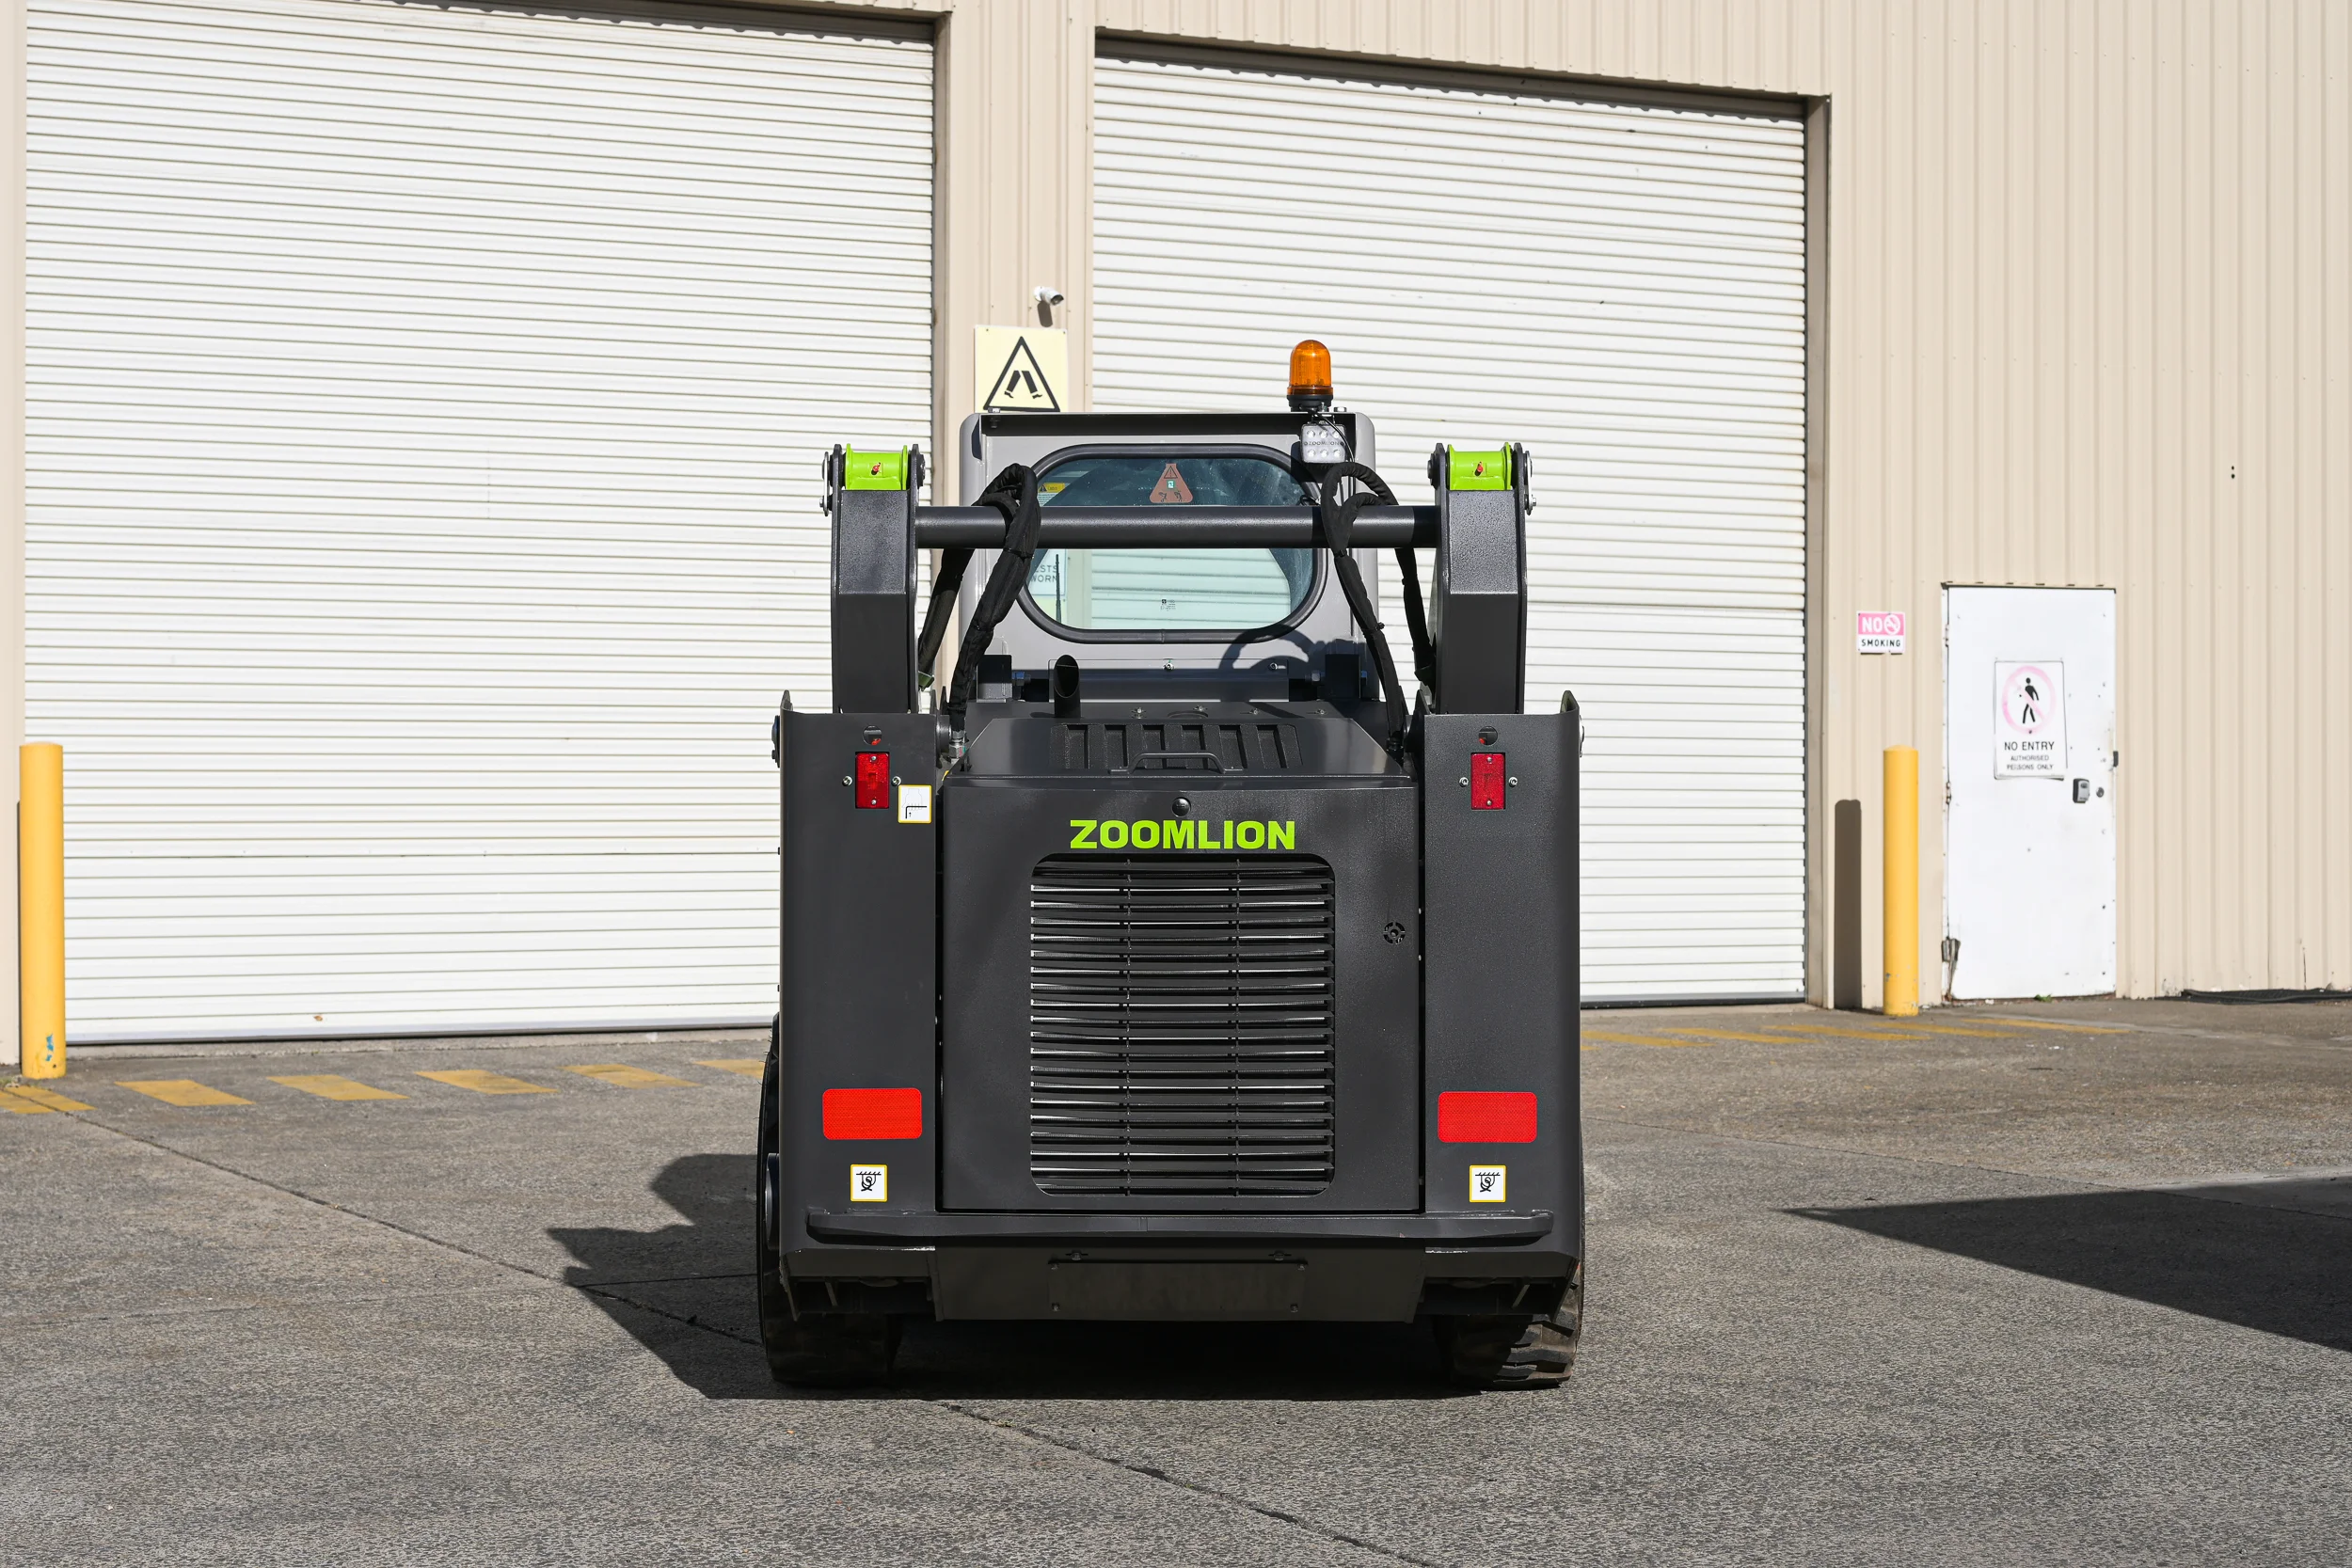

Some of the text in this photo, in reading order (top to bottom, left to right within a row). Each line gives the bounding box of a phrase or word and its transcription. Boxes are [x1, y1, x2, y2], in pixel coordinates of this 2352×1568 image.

[1862, 617, 1883, 632] NO
[1861, 639, 1900, 647] SMOKING
[2004, 741, 2055, 751] NO ENTRY
[1070, 819, 1295, 850] ZOOMLION
